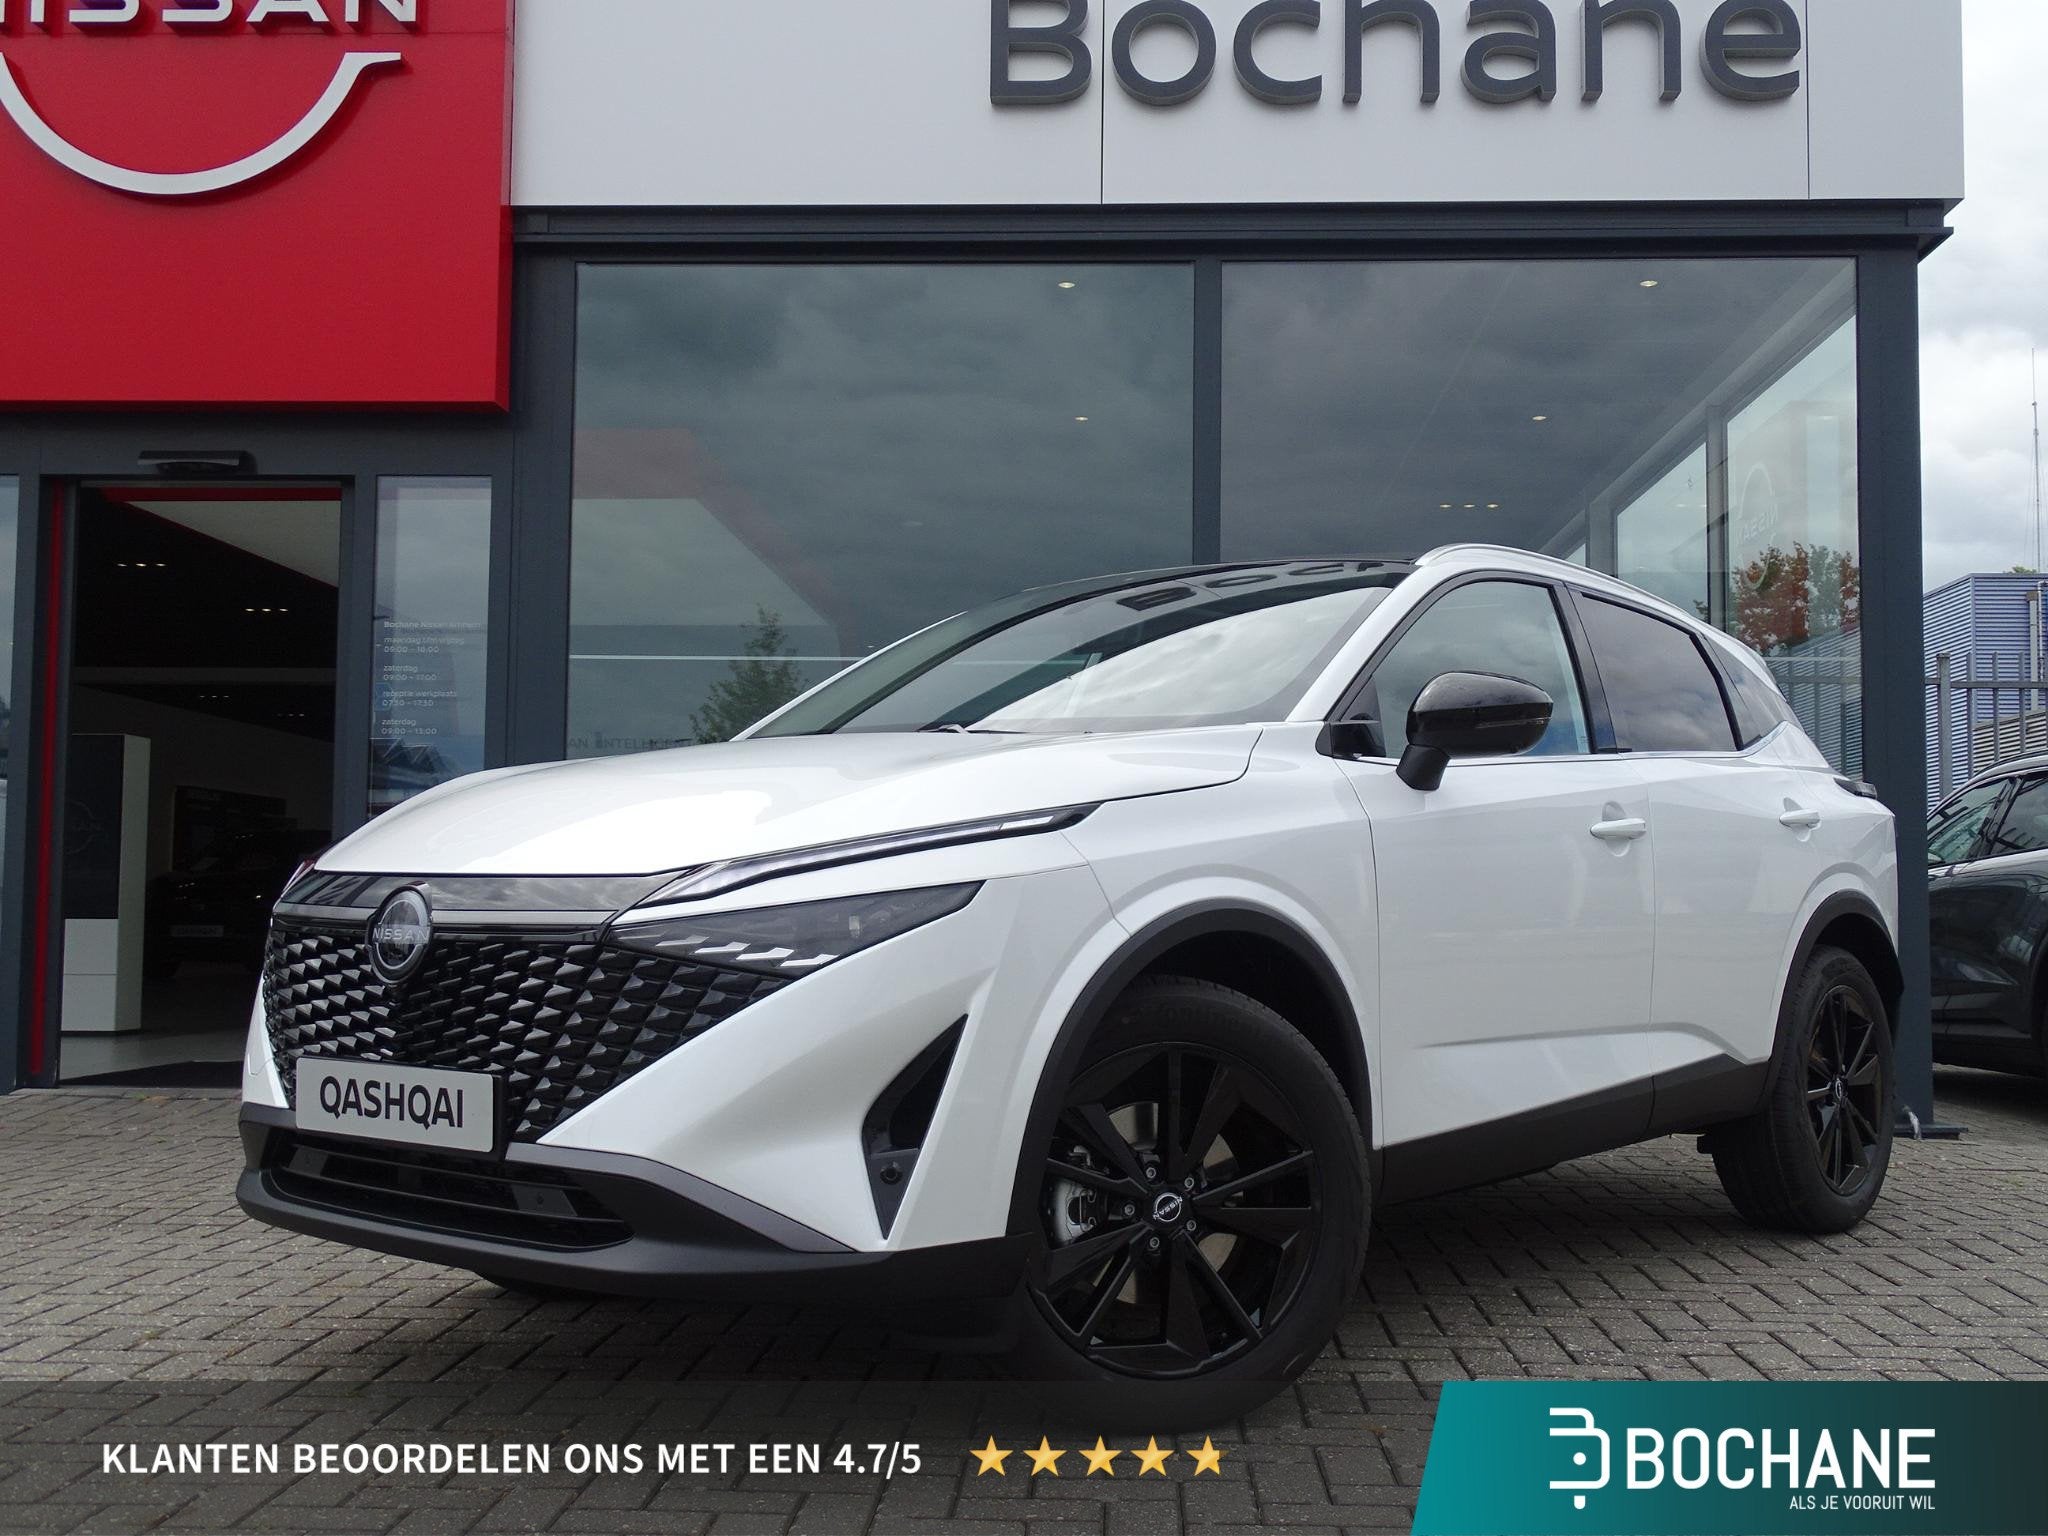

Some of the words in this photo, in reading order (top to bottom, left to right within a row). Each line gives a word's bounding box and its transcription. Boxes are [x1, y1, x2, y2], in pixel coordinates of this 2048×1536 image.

[990, 0, 1802, 105] Bochane
[373, 926, 430, 945] NISSAN
[319, 1075, 464, 1131] QASHQAI
